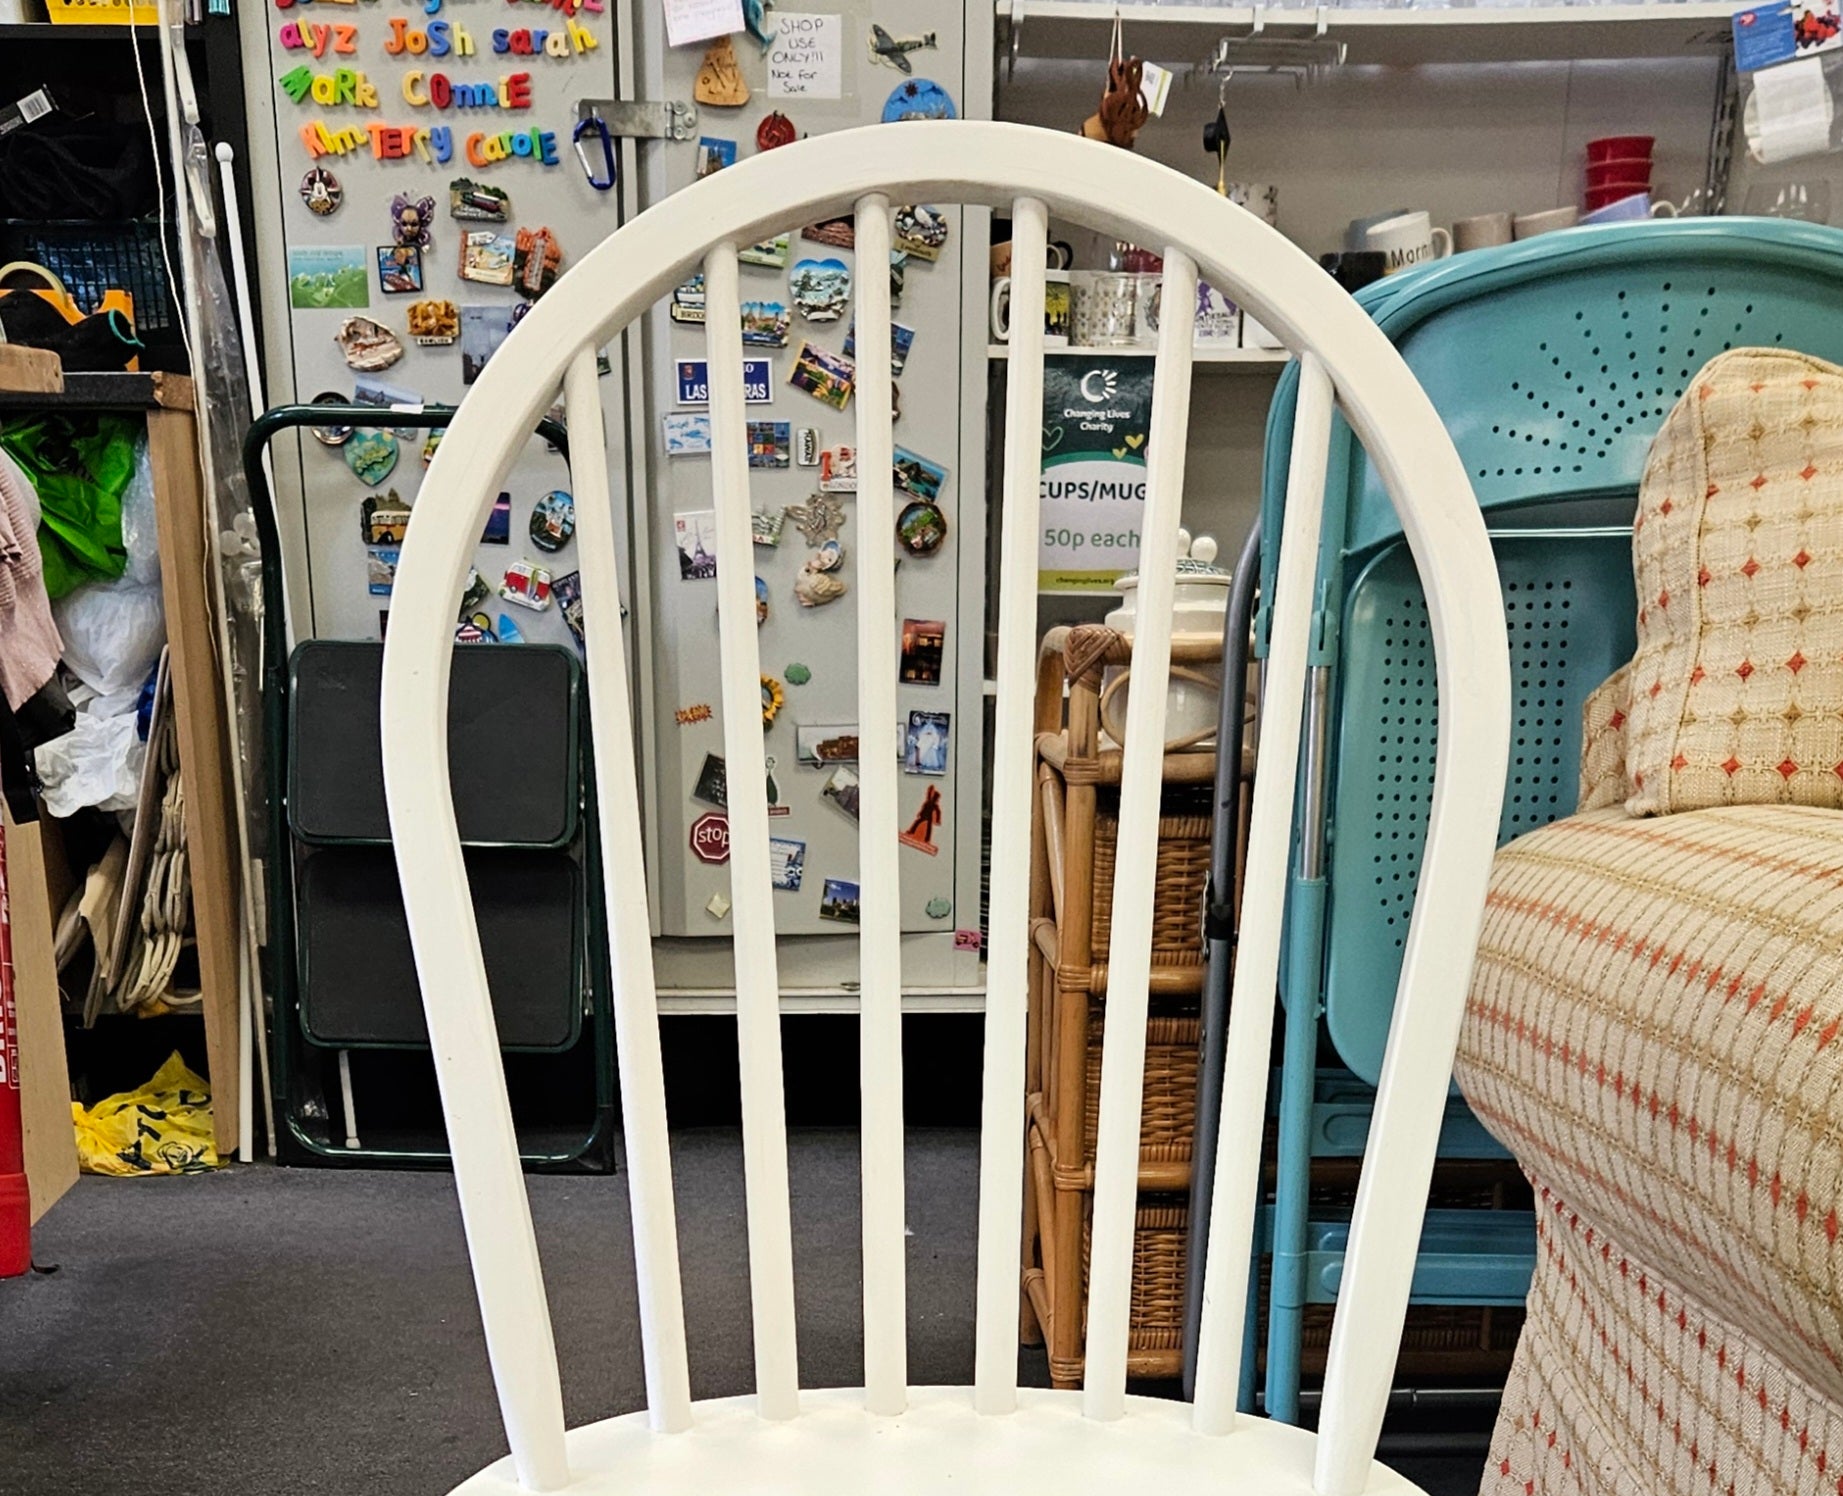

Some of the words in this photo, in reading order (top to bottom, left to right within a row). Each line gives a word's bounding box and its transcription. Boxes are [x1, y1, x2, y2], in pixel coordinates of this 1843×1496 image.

[780, 18, 824, 35] SHOP
[788, 37, 817, 49] USE
[1390, 243, 1429, 269] Morn
[686, 385, 708, 400] LAS
[743, 383, 767, 399] RAS
[1063, 408, 1106, 421] Changing
[1107, 408, 1131, 420] Lives
[1079, 421, 1115, 434] Charity
[1040, 481, 1145, 501] CUPS/MUG
[1044, 528, 1085, 551] 50p
[1090, 530, 1141, 549] each
